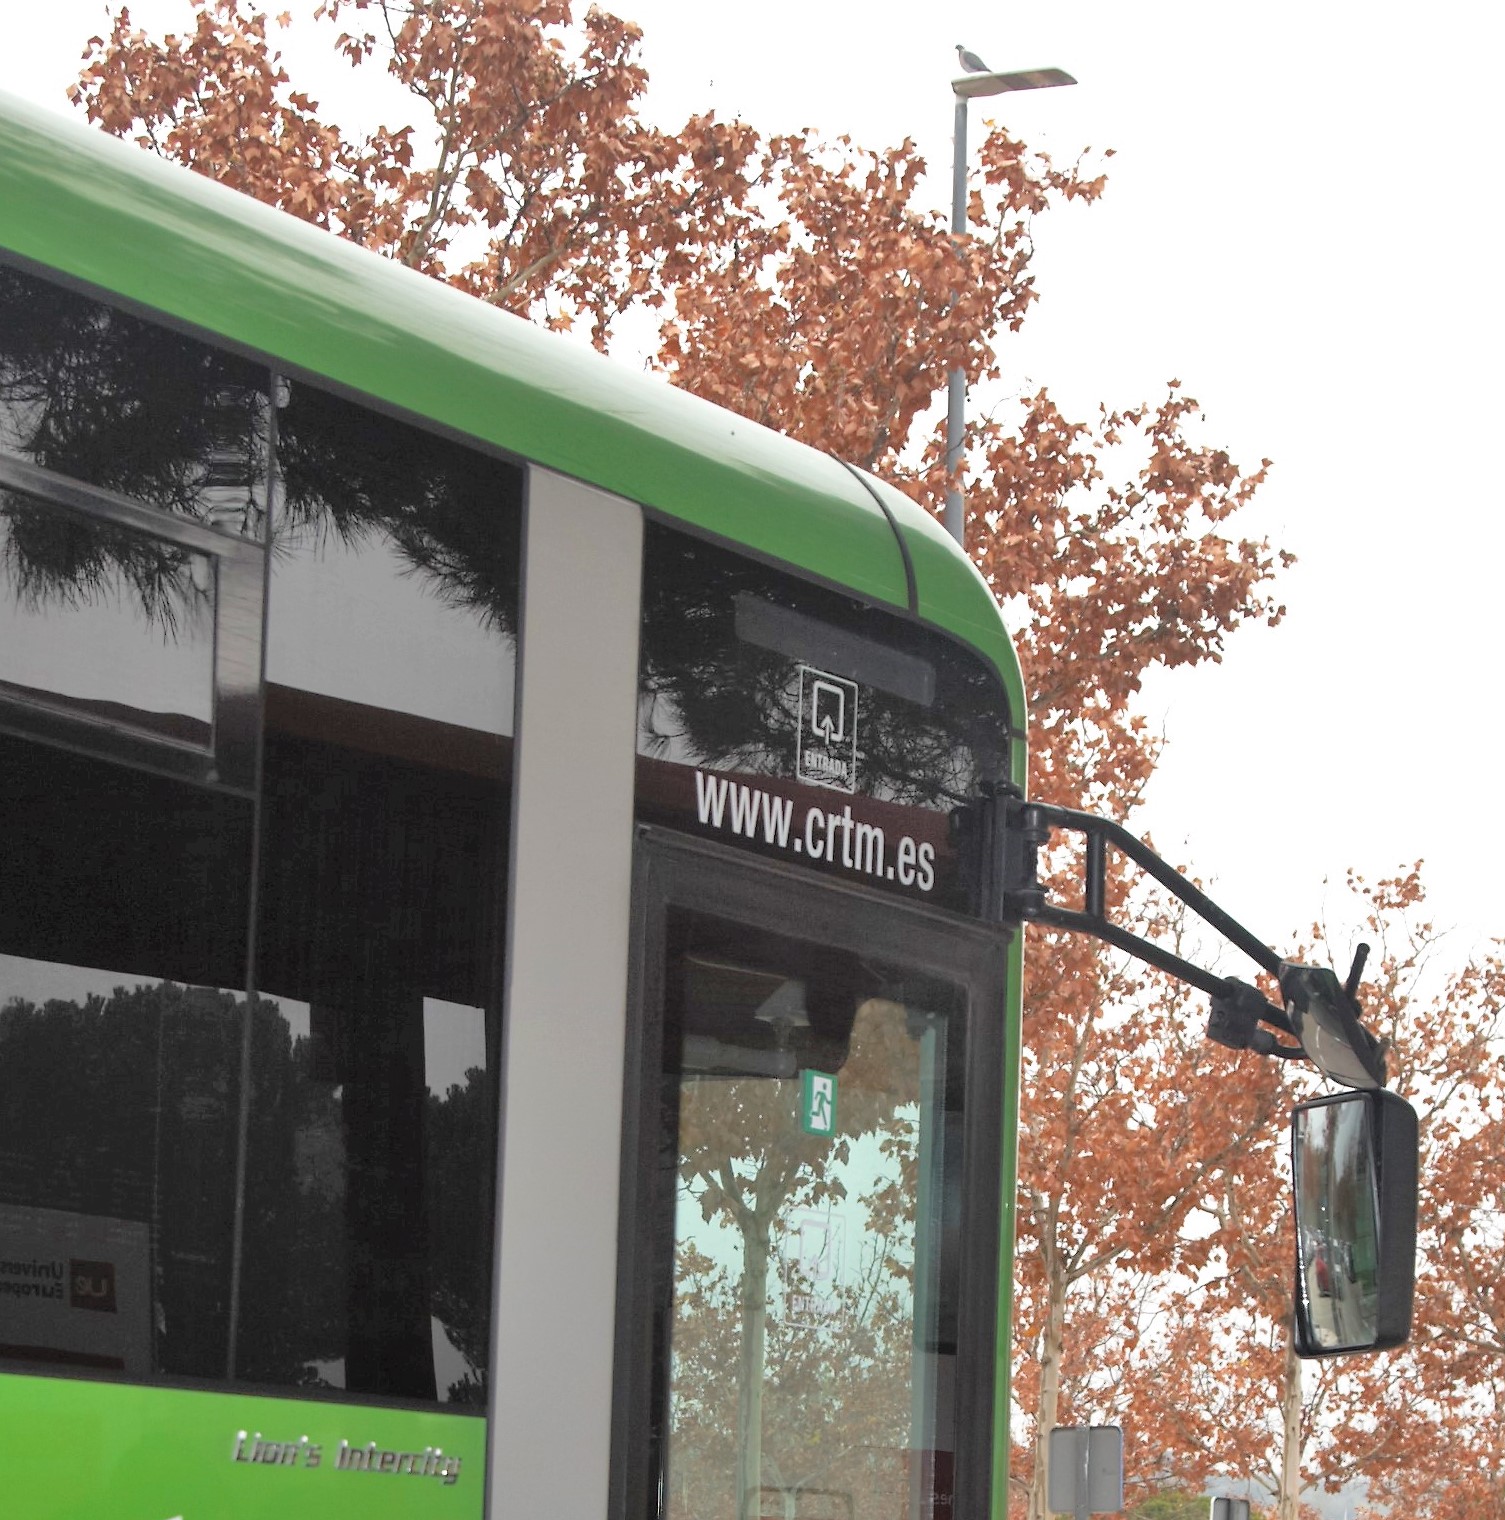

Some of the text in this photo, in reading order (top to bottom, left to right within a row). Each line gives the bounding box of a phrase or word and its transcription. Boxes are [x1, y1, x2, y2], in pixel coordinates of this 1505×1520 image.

[804, 749, 848, 779] ENTRADA
[696, 770, 936, 892] www.crtm.es
[232, 1430, 463, 1485] Lion's Intercity
